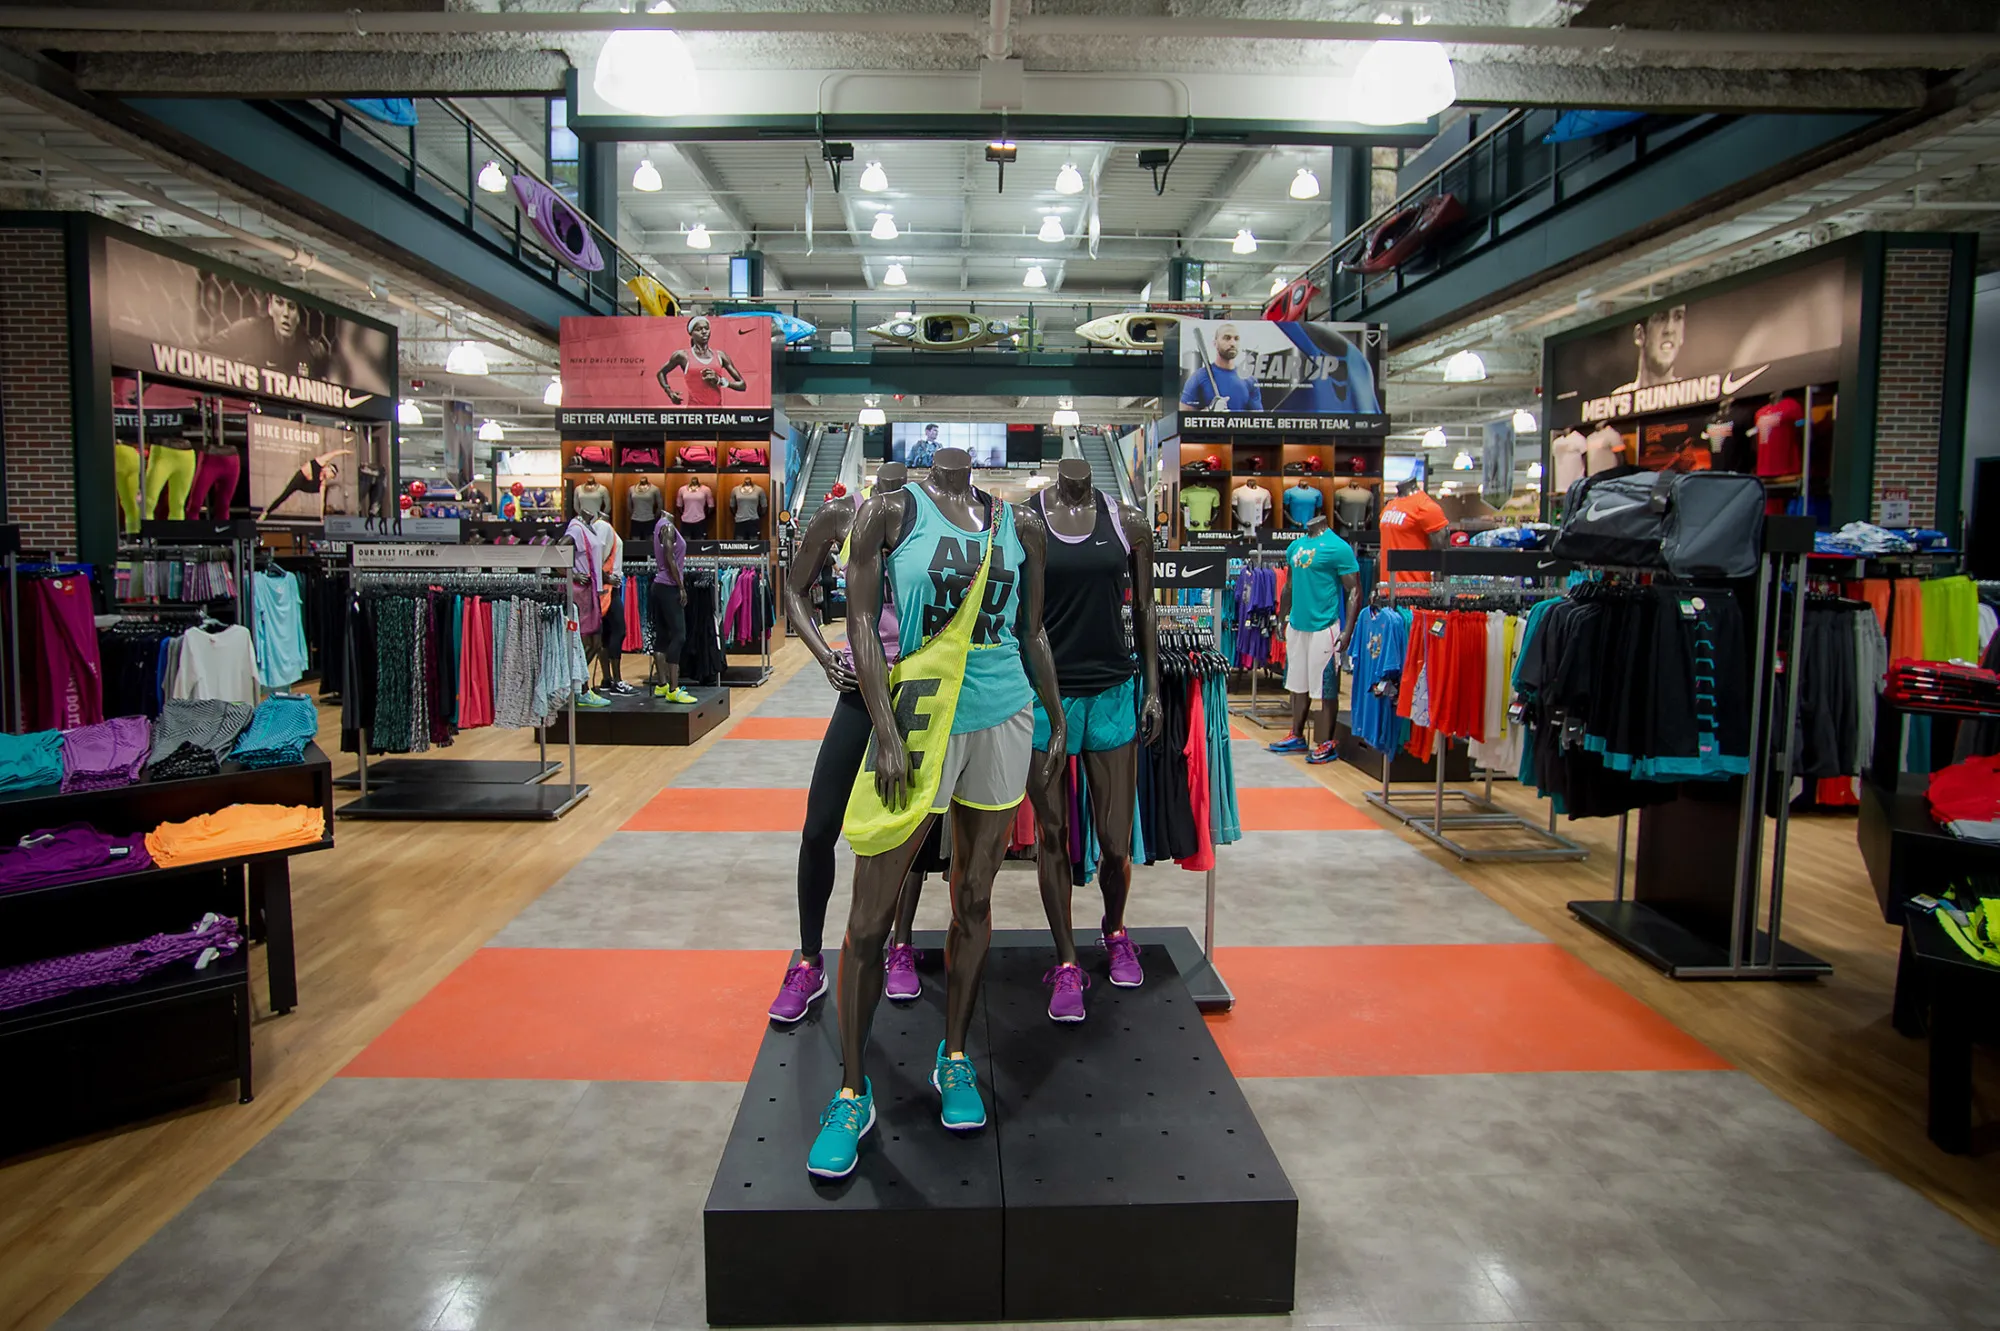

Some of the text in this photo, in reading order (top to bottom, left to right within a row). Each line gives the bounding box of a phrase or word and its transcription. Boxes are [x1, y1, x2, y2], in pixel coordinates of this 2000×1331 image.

[152, 343, 344, 408] WOMEN'S TRAINING
[1238, 355, 1339, 381] GEAR UP
[1581, 374, 1721, 423] MEN'S RUNNING
[254, 422, 321, 444] NIKE LEGEND
[562, 413, 604, 424] BETTER
[606, 413, 657, 424] ATHLETE.
[660, 414, 703, 424] BETTER
[705, 414, 738, 424] TEAM.
[1184, 416, 1225, 428] BETTER
[1227, 417, 1275, 429] ATHLETE.
[1277, 418, 1318, 429] BETTER
[1320, 419, 1350, 430] TEAM.
[927, 536, 1015, 583] ALL
[922, 604, 1006, 644] RN
